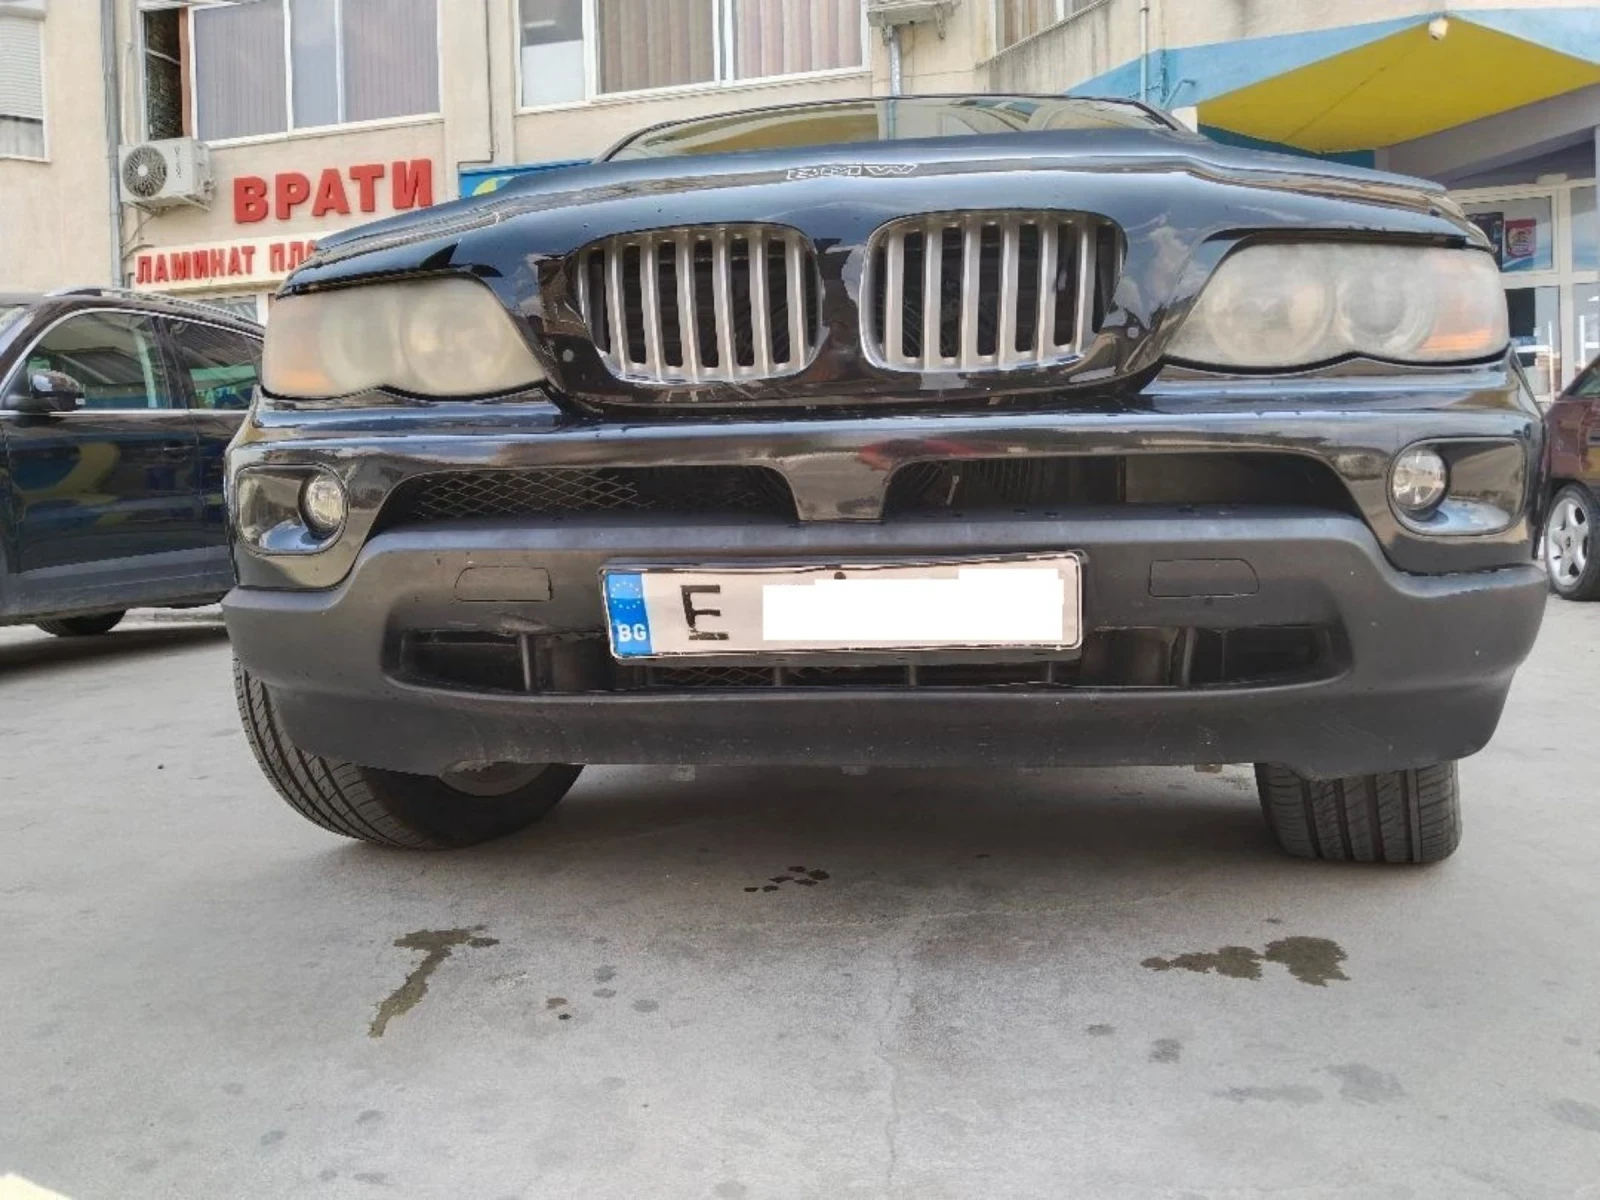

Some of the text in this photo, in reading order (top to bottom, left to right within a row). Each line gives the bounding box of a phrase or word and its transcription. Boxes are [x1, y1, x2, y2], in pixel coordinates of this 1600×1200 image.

[233, 158, 433, 224] ВРАТИ
[136, 246, 256, 284] ЛАМИНАТ
[617, 584, 730, 642] BG E
